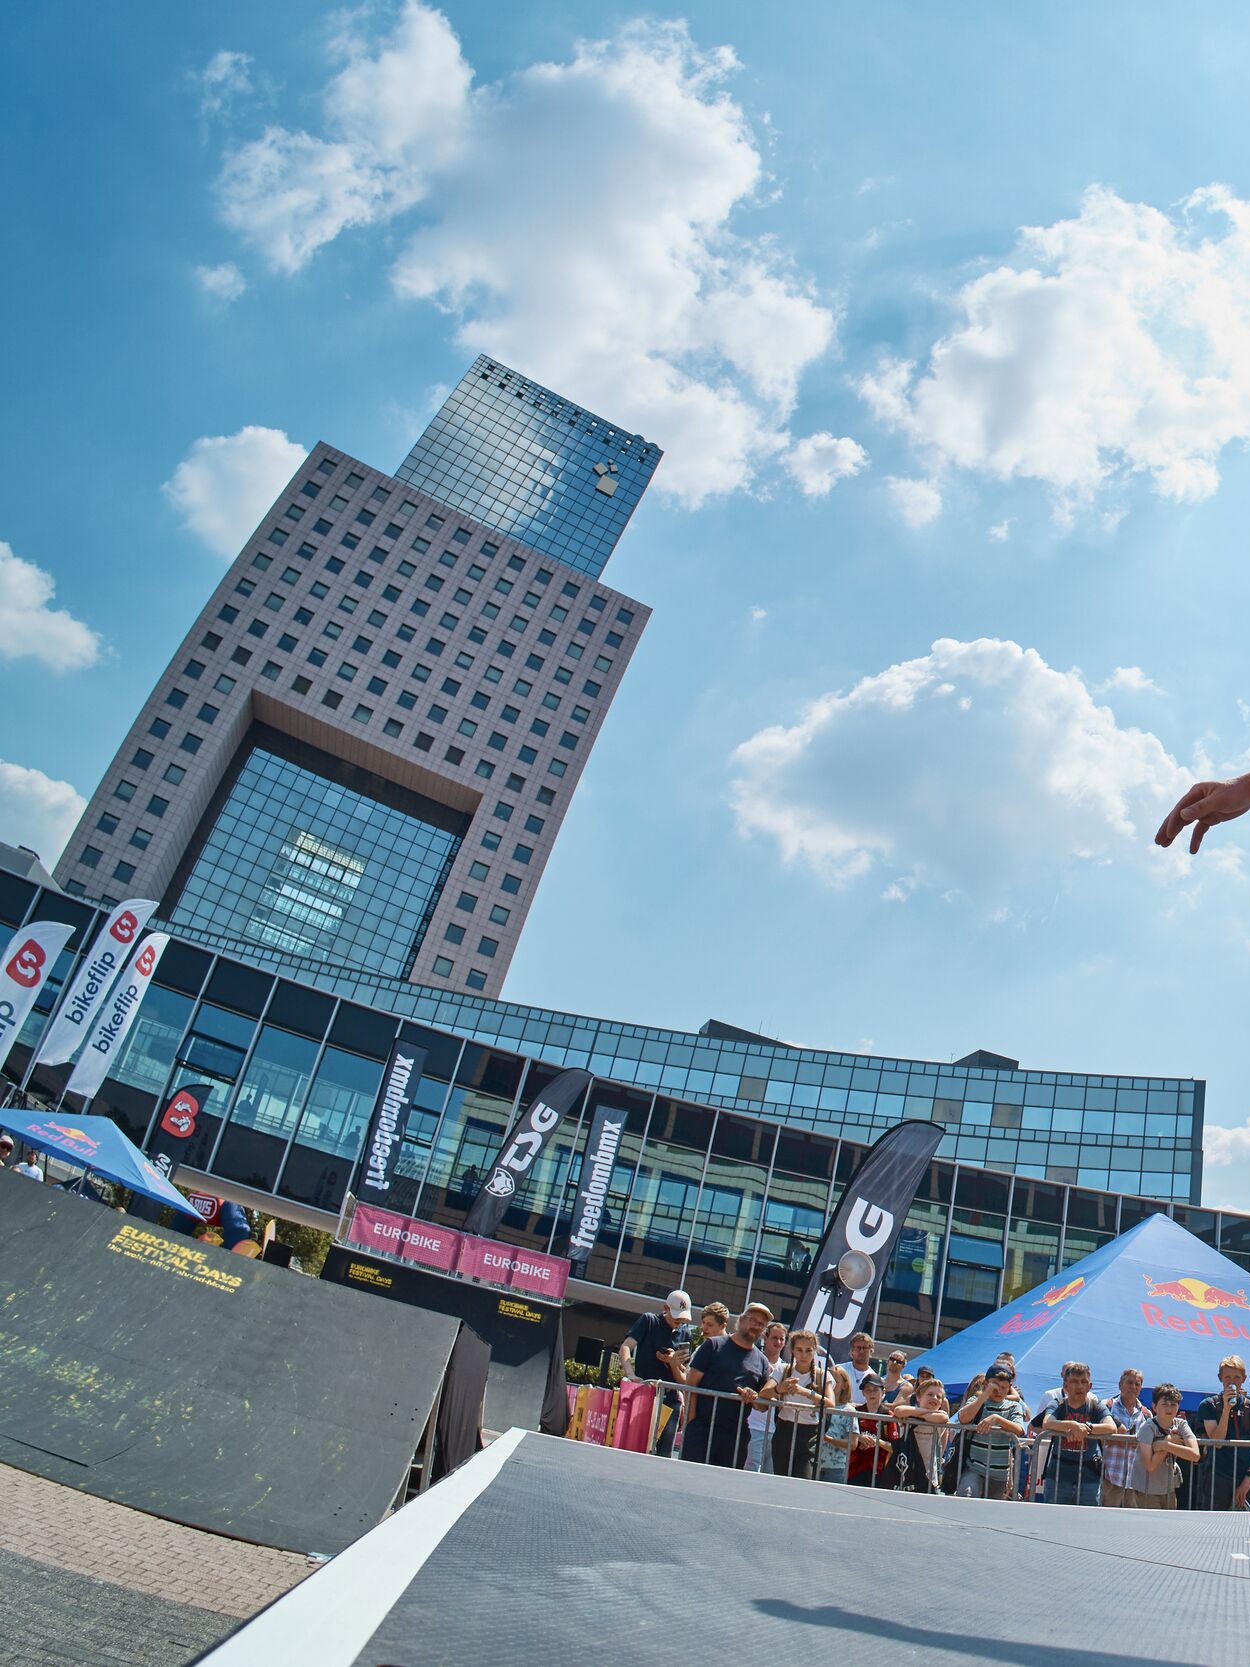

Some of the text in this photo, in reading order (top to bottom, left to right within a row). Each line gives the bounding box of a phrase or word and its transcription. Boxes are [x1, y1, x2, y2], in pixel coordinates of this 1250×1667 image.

[65, 951, 116, 1026] bikeflip
[92, 984, 139, 1054] bikeflip
[26, 1124, 97, 1157] Red Bull
[501, 1102, 559, 1172] TSG
[571, 1119, 622, 1249] freedombmx
[120, 1225, 208, 1263] EUROBIKE
[373, 1223, 441, 1252] EUROBIKE
[111, 1234, 242, 1287] FESTIVAL DAYS
[483, 1253, 551, 1281] EUROBIKE
[1140, 1301, 1213, 1336] Red
